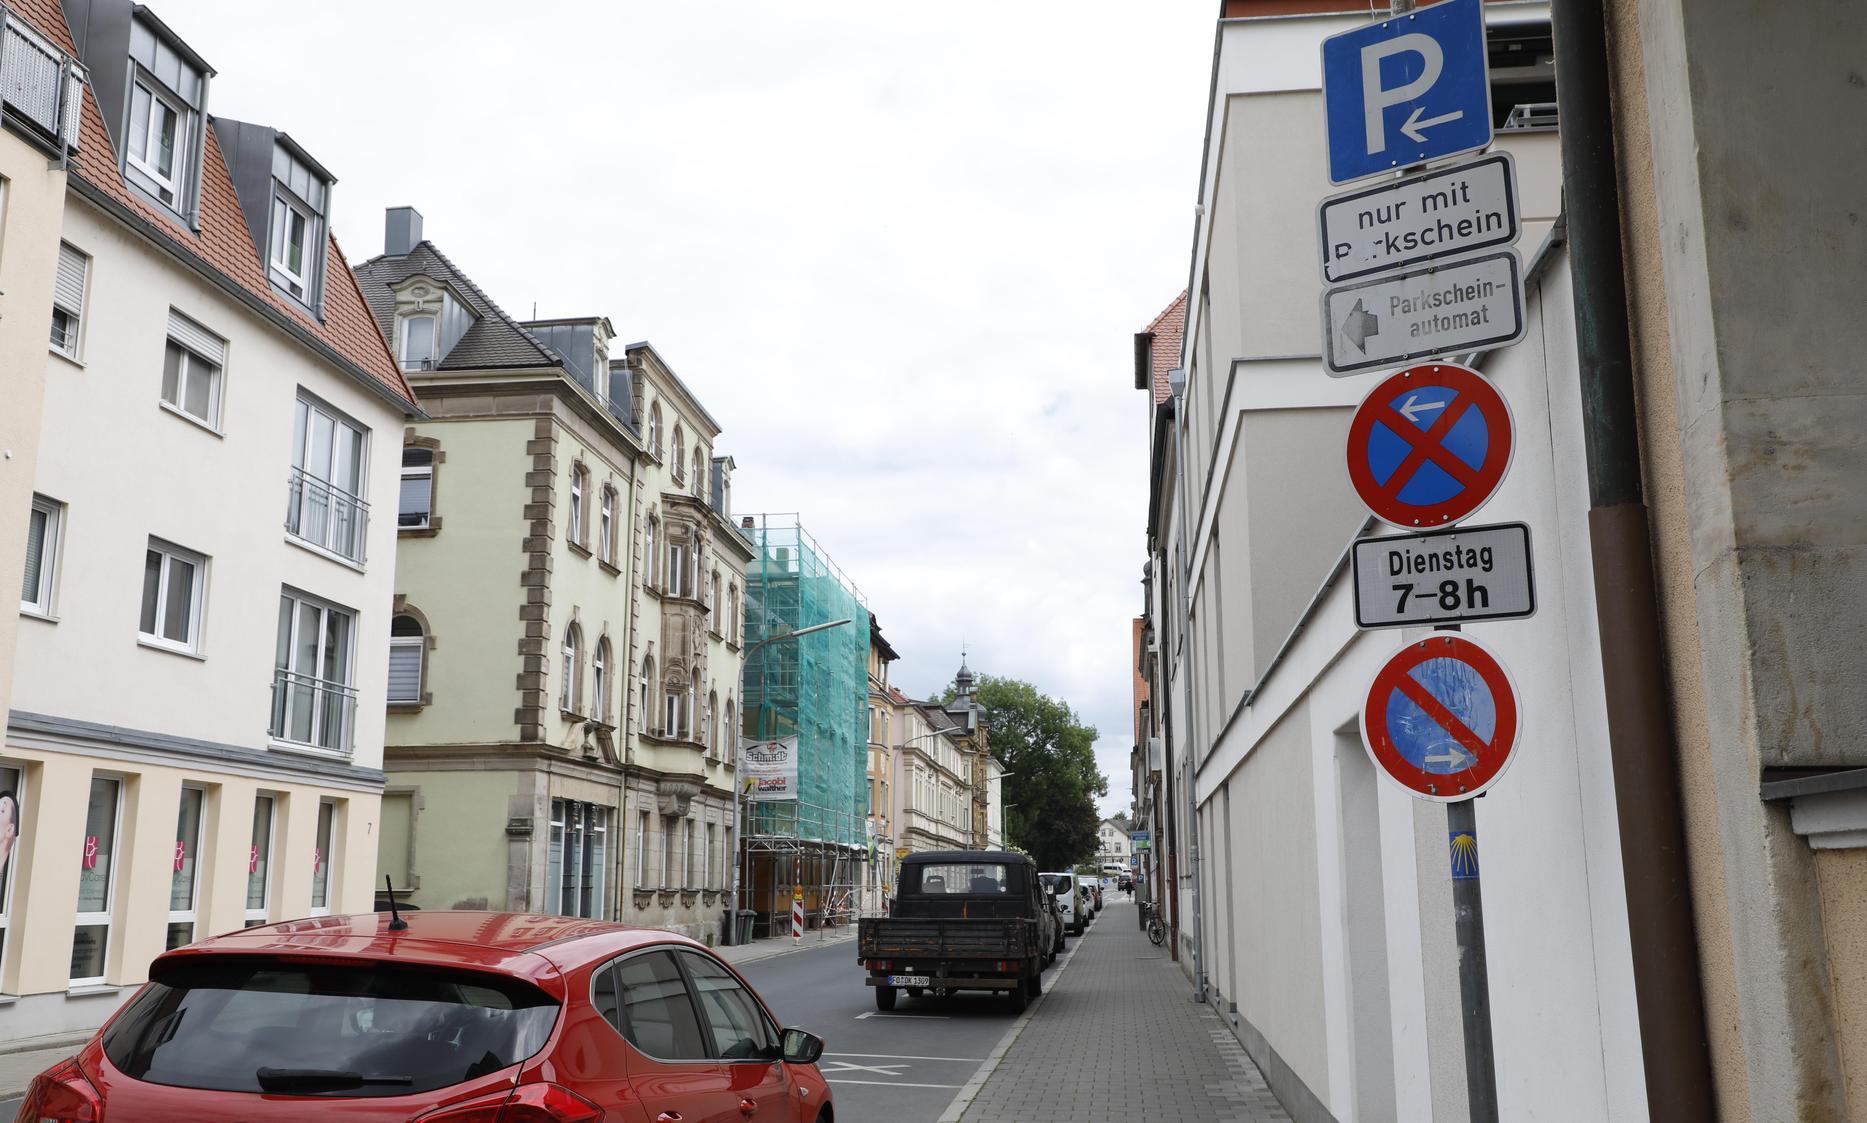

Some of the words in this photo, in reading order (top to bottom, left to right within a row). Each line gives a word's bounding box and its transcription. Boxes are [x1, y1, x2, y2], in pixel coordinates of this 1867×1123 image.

[1361, 33, 1444, 155] P
[1358, 200, 1406, 229] nur
[1421, 181, 1470, 213] mit
[1334, 210, 1502, 260] Pkschein
[1389, 278, 1506, 316] Parkschein-
[1410, 304, 1489, 338] automat
[1388, 545, 1494, 577] Dienstag
[746, 751, 788, 762] Schmidt
[367, 822, 373, 835] 7
